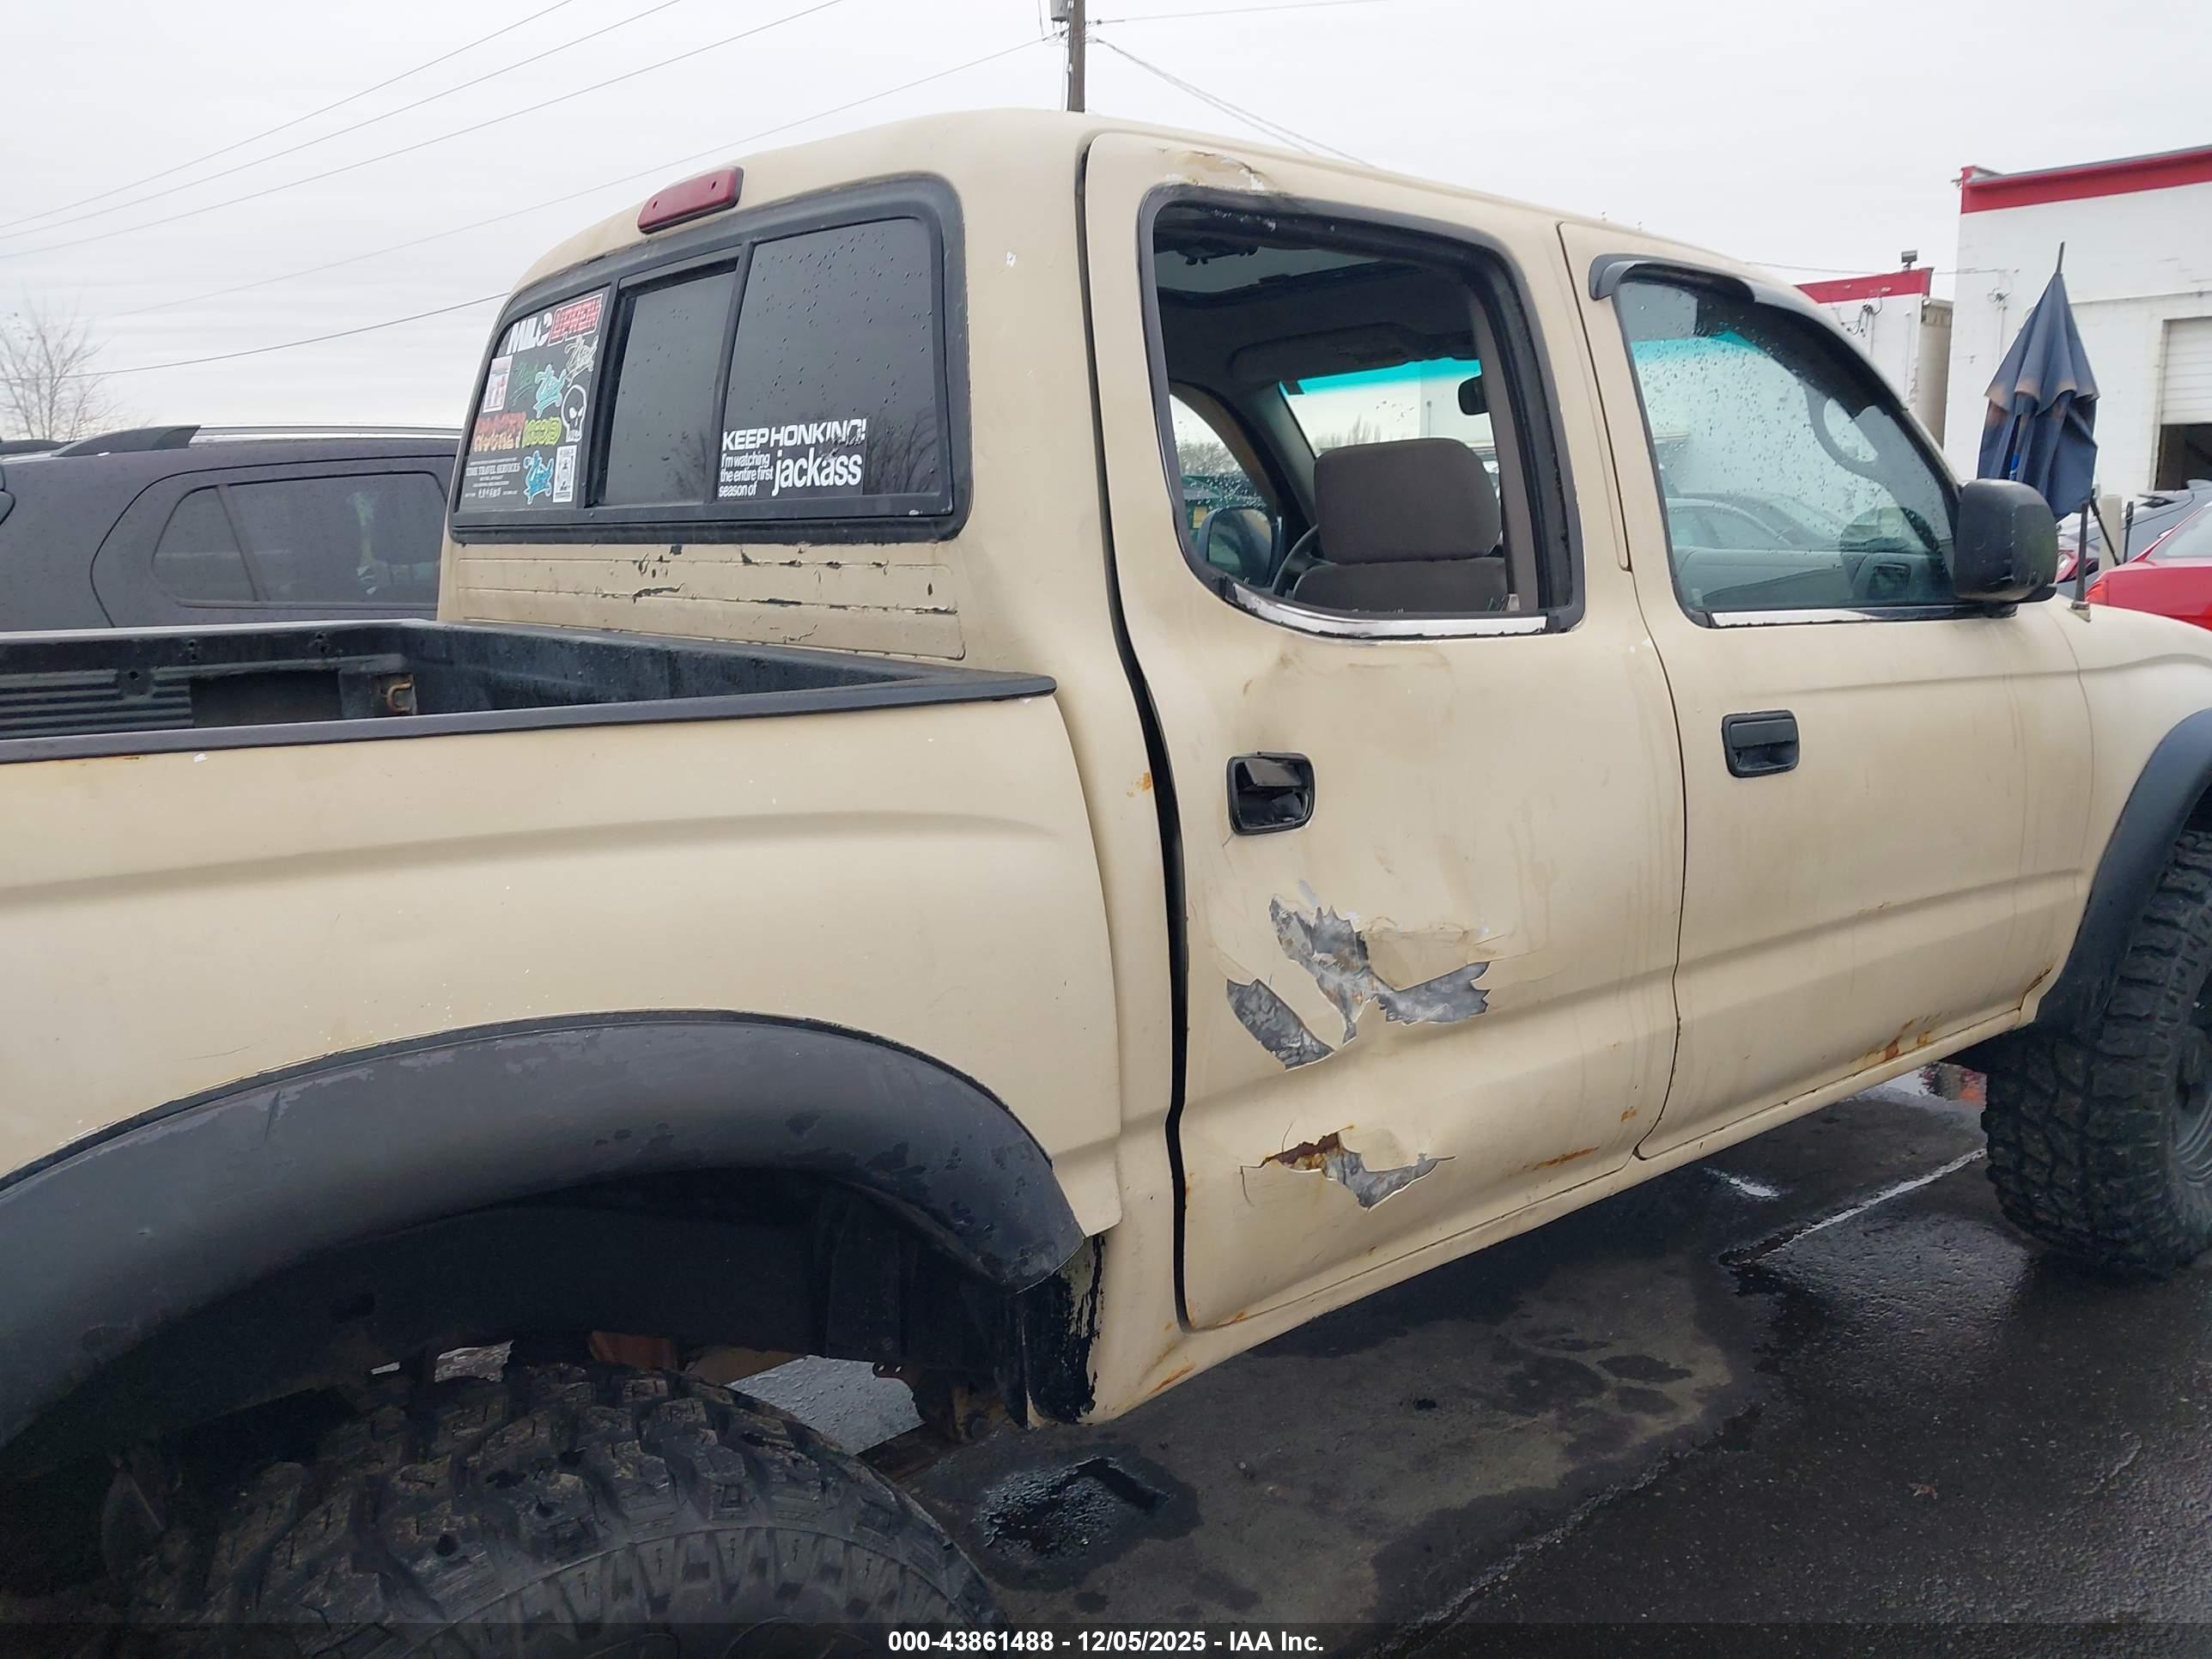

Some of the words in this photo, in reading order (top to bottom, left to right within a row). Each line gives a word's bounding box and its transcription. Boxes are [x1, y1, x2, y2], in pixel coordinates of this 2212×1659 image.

[722, 428, 769, 451] KEEP
[721, 453, 733, 468] I'm
[733, 452, 770, 468] watching
[720, 469, 733, 483] the
[734, 468, 757, 482] entire
[757, 465, 774, 481] first
[772, 447, 863, 496] jackass
[719, 483, 747, 497] season
[748, 481, 757, 496] of
